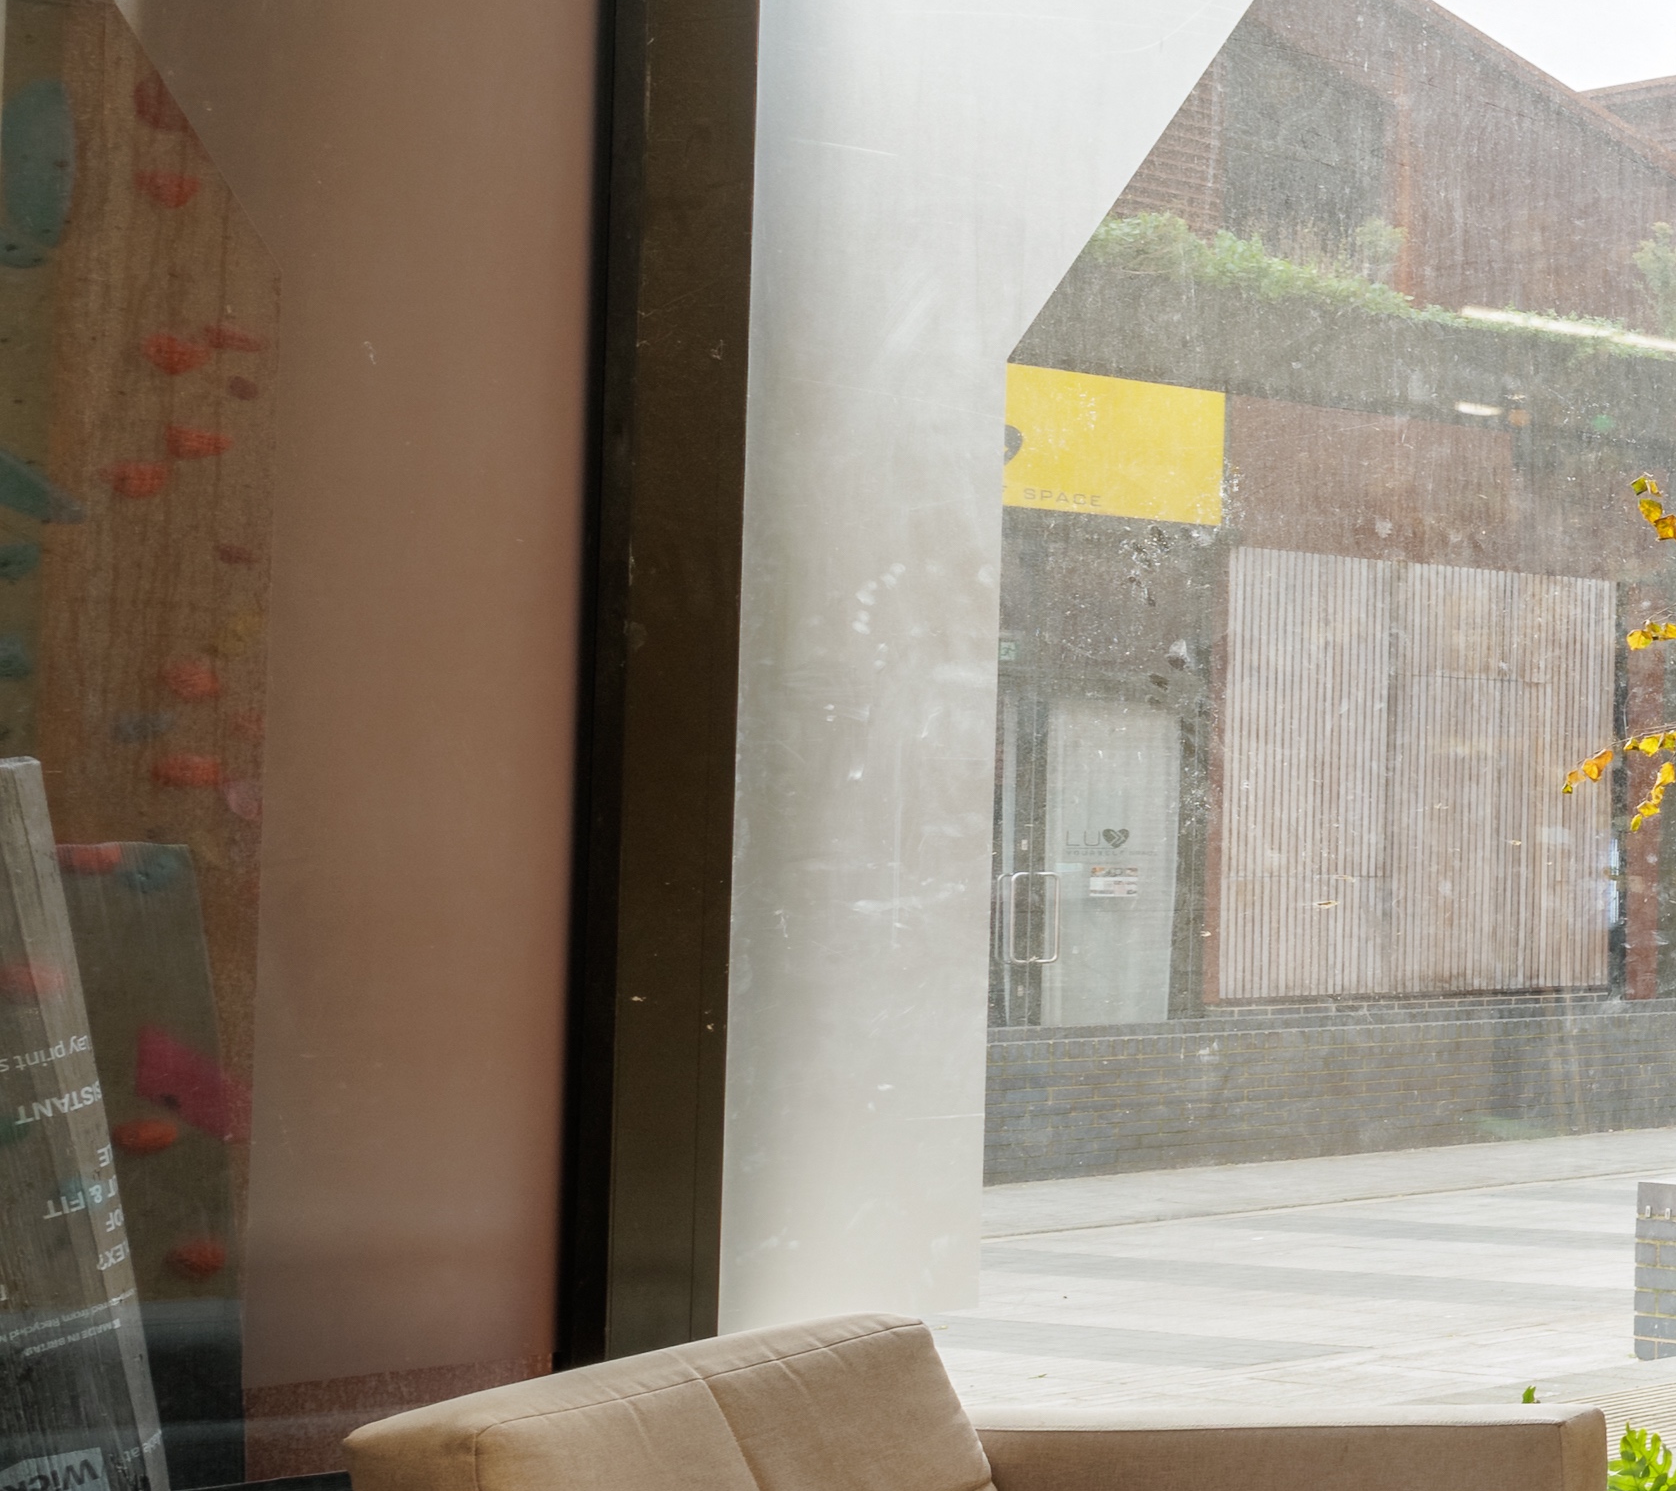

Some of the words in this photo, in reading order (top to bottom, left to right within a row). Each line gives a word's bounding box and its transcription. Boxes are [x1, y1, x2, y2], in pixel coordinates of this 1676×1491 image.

[1023, 487, 1102, 507] SPACE
[16, 1041, 65, 1070] print
[43, 1191, 86, 1220] FIT
[67, 1332, 80, 1343] IN
[81, 1322, 115, 1339] MADE
